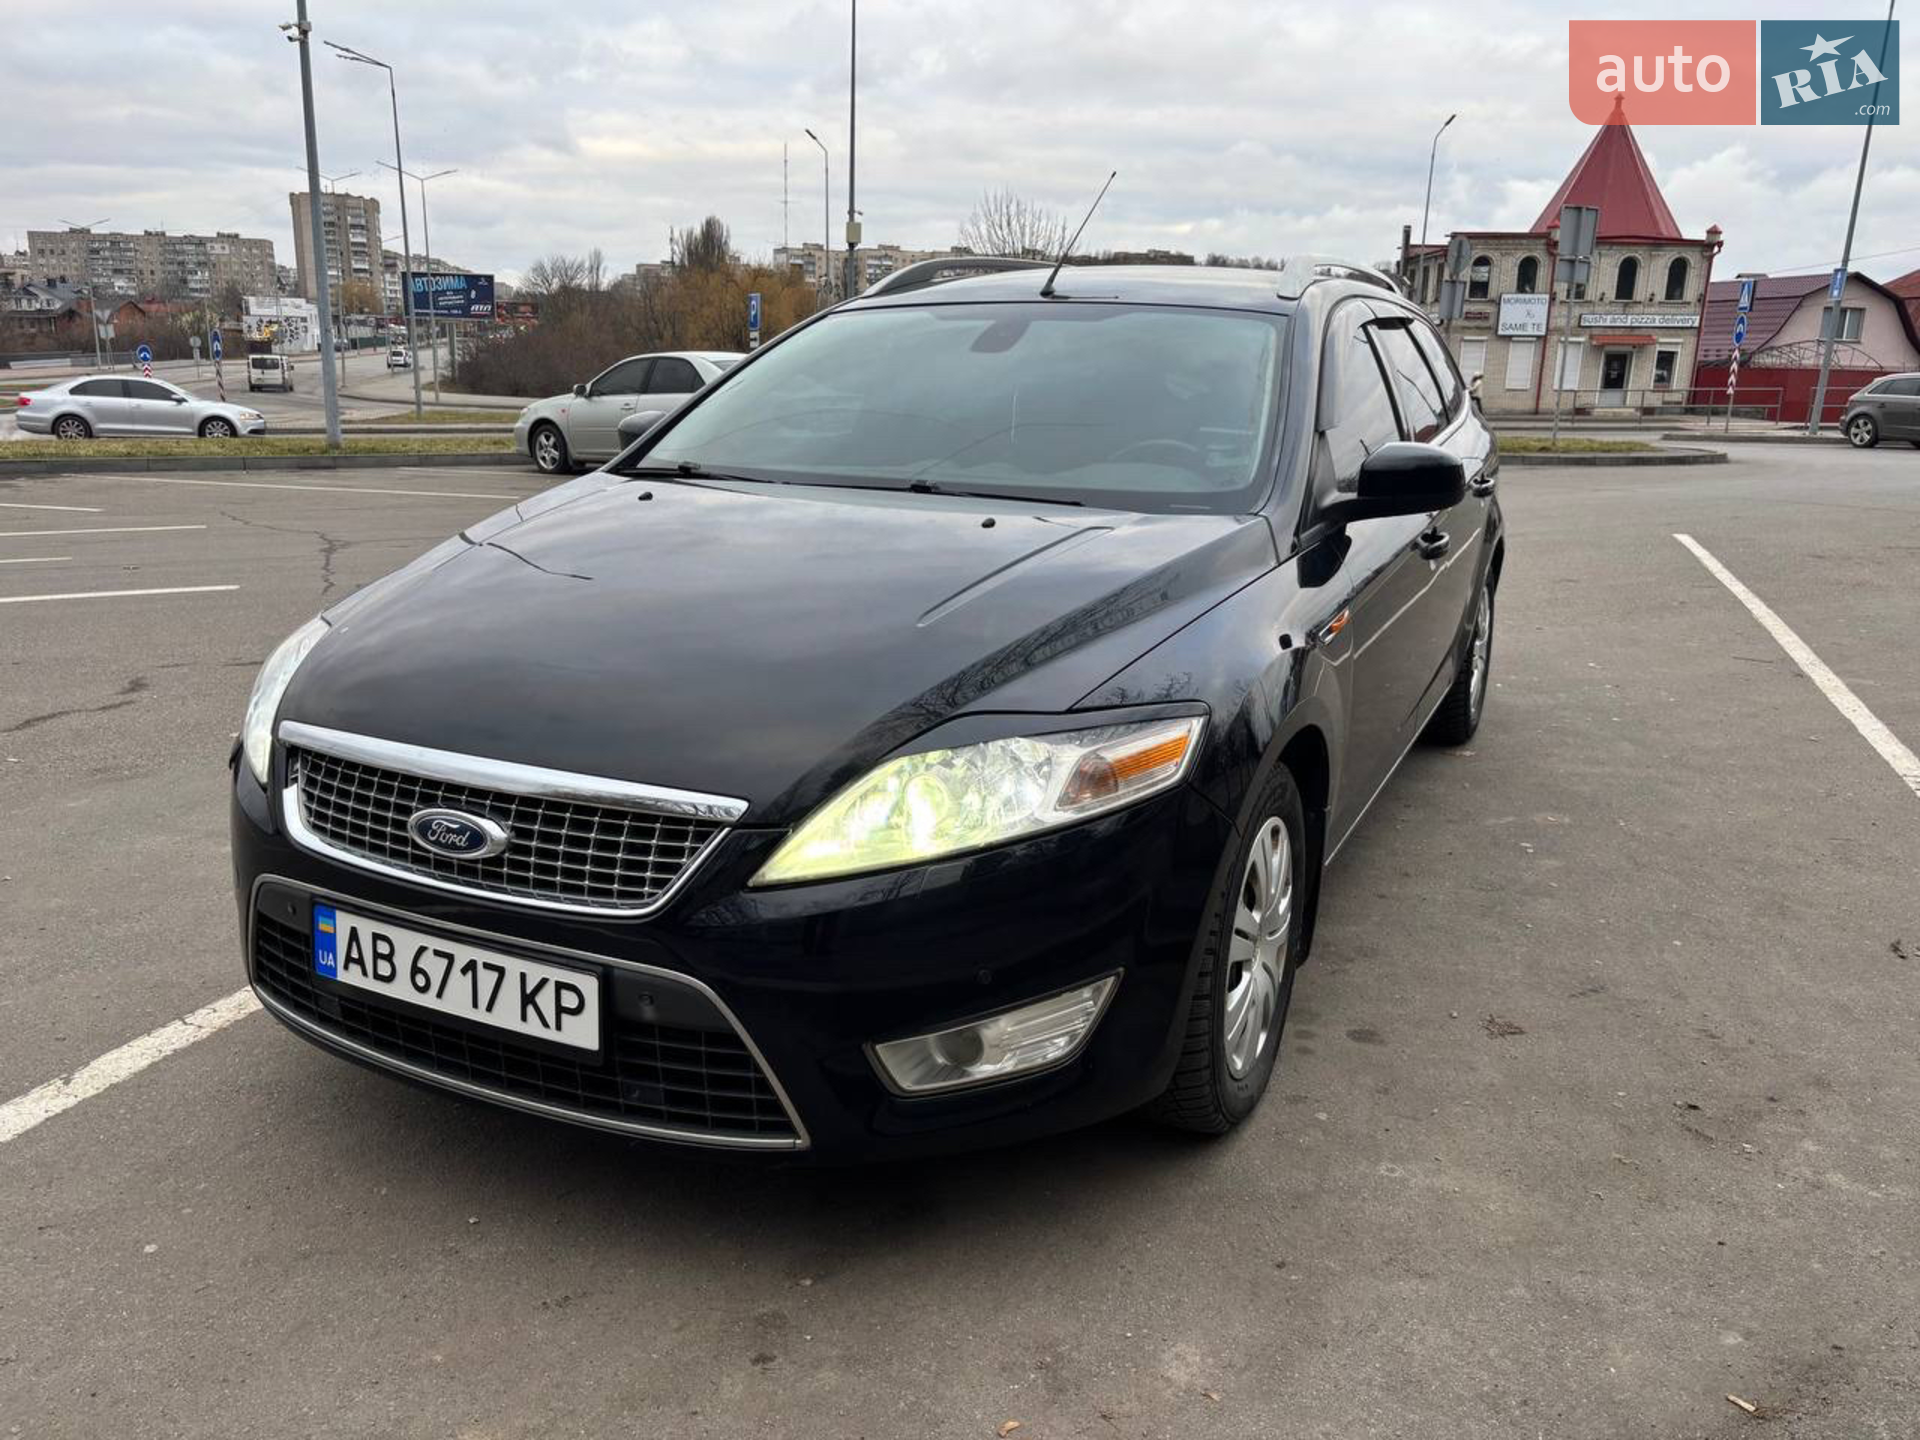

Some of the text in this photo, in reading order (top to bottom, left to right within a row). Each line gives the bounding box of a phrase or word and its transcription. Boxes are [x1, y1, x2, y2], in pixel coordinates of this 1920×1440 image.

[1502, 297, 1547, 305] MORIMOTO
[1501, 323, 1543, 332] SAME TE
[1582, 315, 1697, 327] sushi and pizza delivery
[427, 819, 471, 847] Ford
[318, 950, 335, 967] UA
[343, 926, 586, 1032] AB 6717 KP
